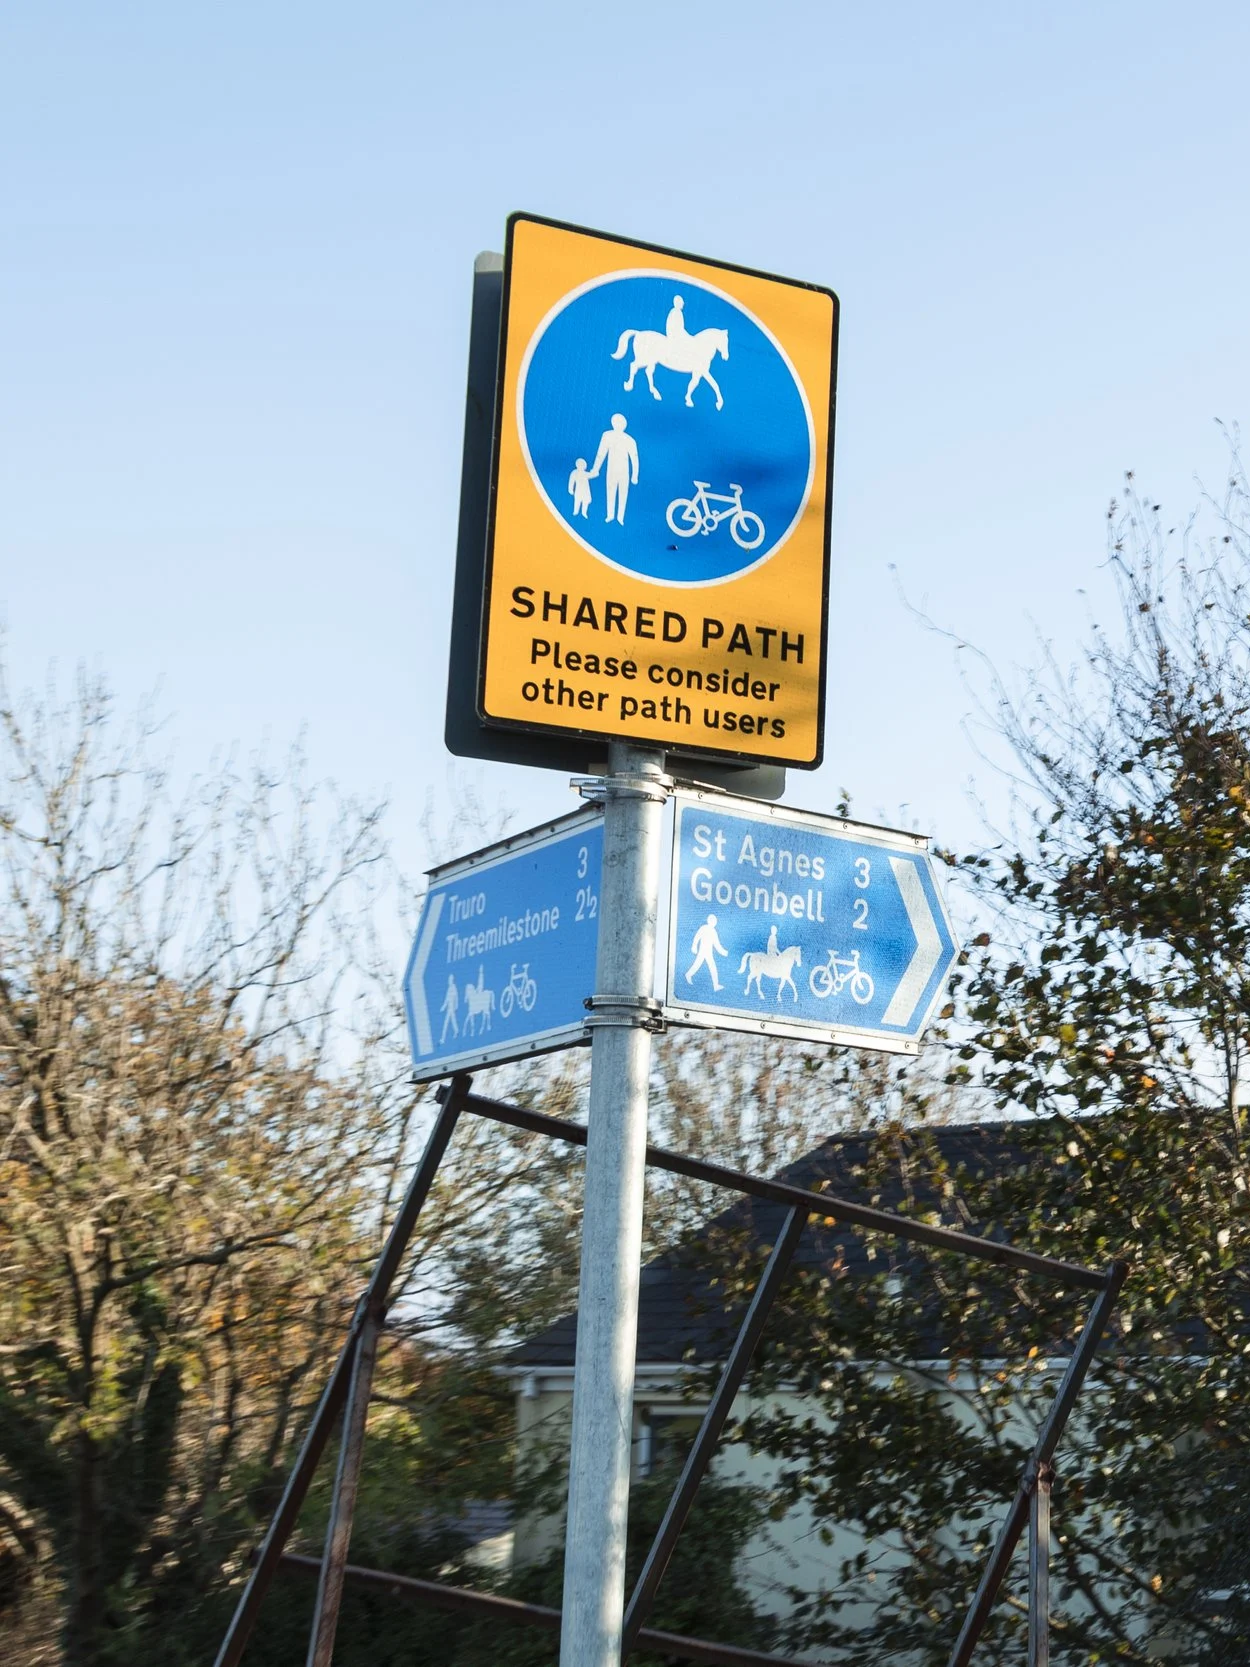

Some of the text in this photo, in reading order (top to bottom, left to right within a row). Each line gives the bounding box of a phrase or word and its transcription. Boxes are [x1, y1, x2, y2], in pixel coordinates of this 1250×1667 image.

[510, 586, 805, 664] SHARED PATH
[530, 638, 781, 701] Please consider
[521, 677, 786, 738] other path users
[449, 846, 588, 924] Truro 3
[692, 825, 871, 888] St Agnes 3
[690, 868, 869, 930] Goonbell 2
[446, 905, 560, 964] Threemilestone
